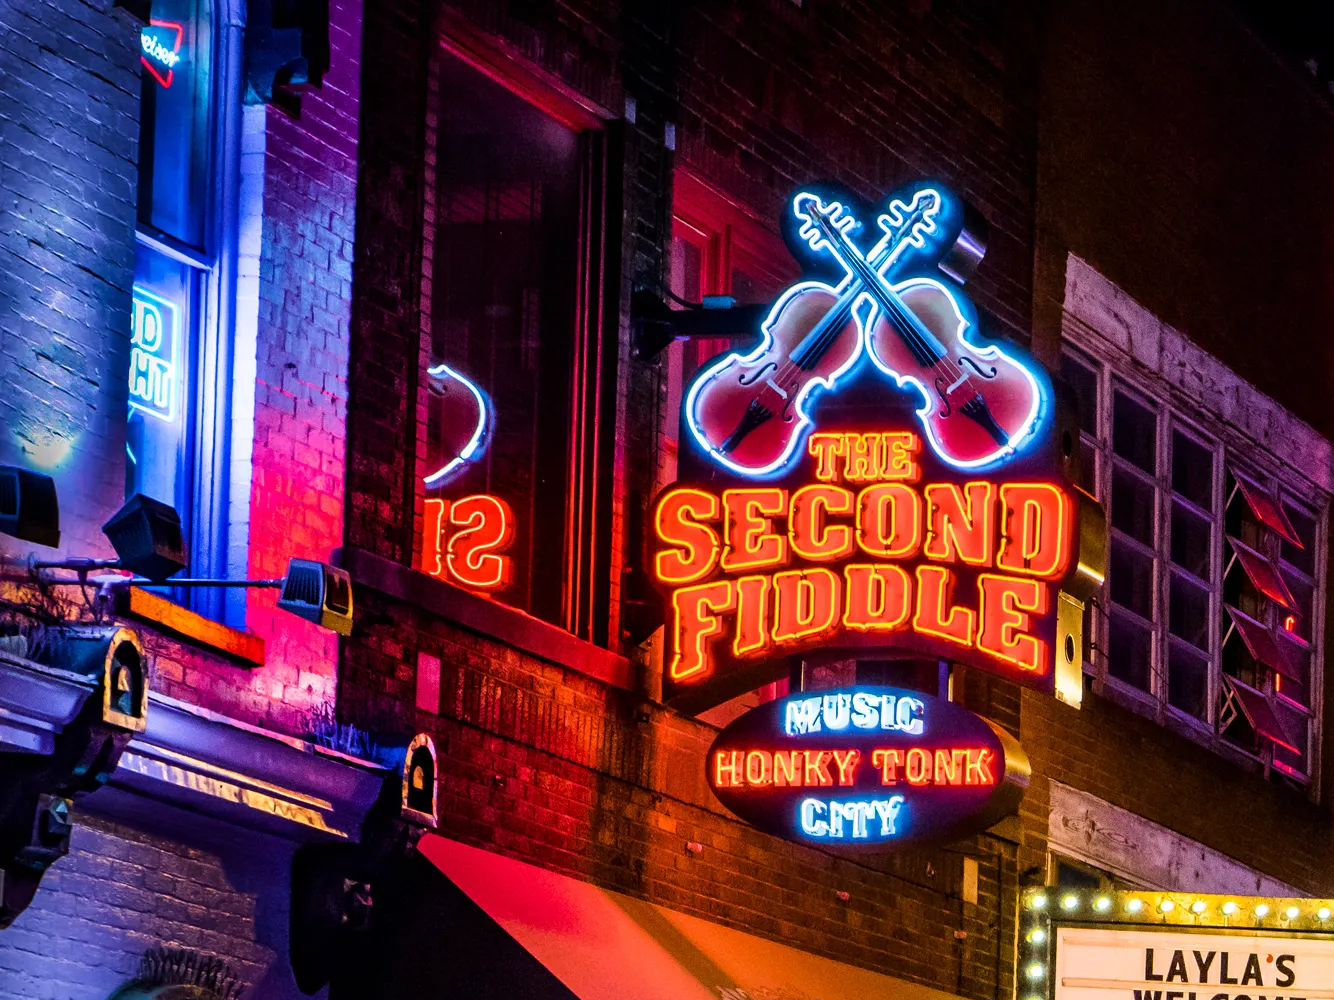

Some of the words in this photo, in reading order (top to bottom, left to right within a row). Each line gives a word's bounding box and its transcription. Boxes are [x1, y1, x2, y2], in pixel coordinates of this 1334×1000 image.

[141, 33, 180, 67] eiser
[809, 432, 918, 481] THE
[655, 482, 1072, 582] SECOND
[671, 564, 1048, 679] FIDDLE
[785, 692, 924, 735] MUSIC
[715, 749, 860, 788] HONKY
[872, 748, 995, 787] TONK
[801, 795, 904, 838] CITY
[1145, 948, 1295, 987] LAYLA'S
